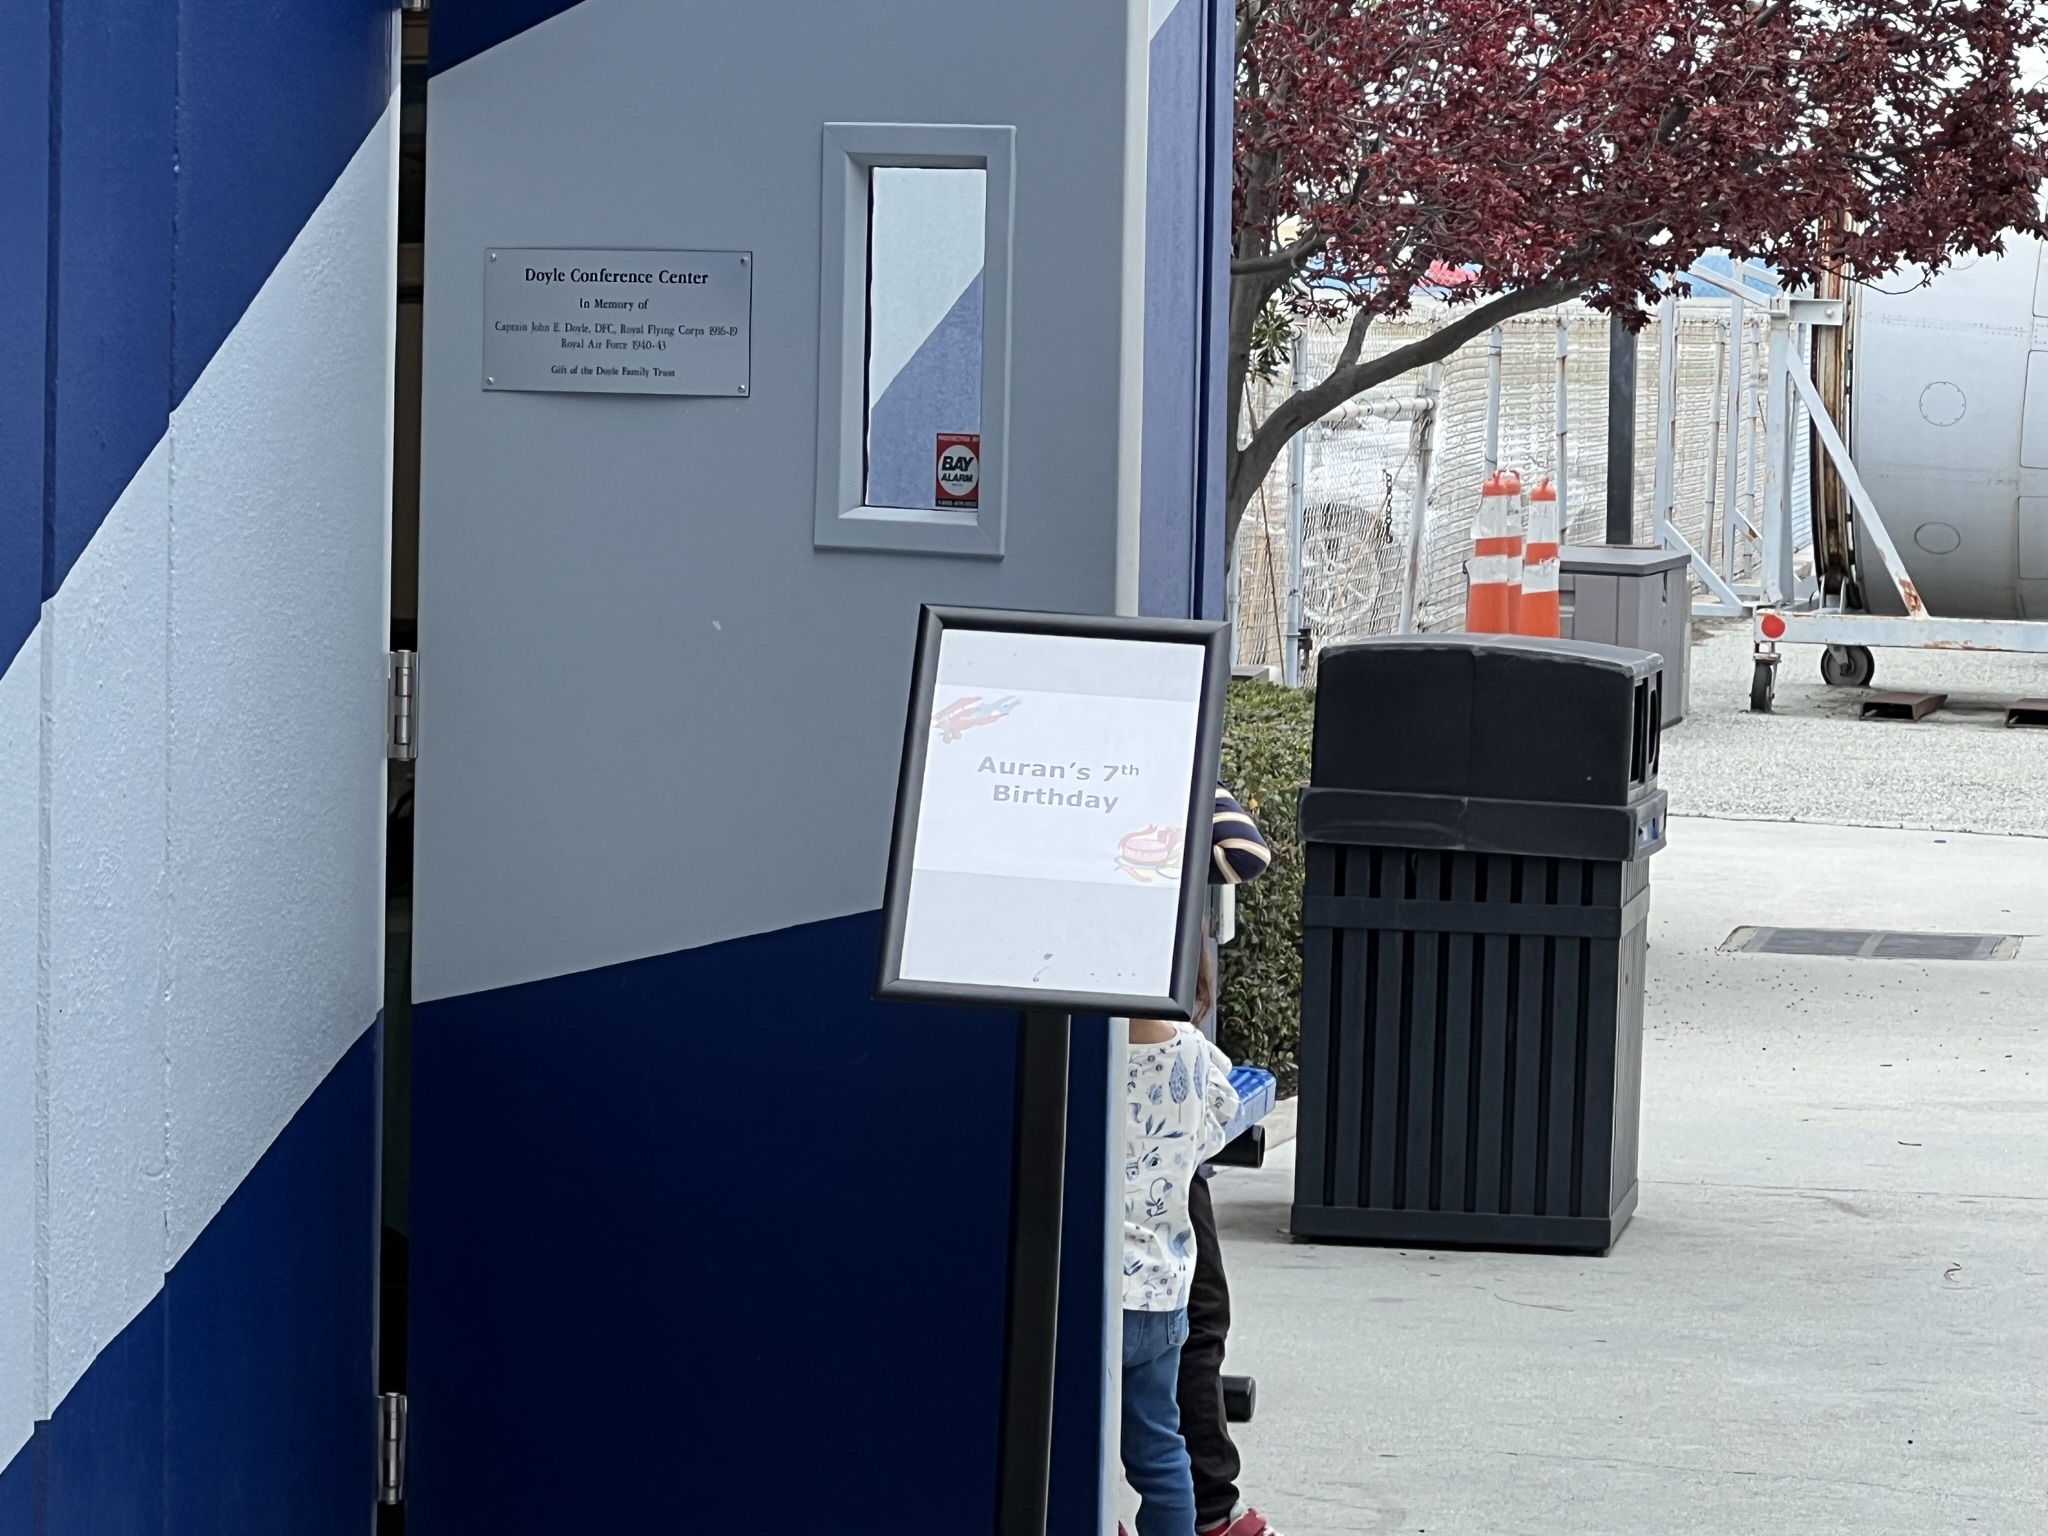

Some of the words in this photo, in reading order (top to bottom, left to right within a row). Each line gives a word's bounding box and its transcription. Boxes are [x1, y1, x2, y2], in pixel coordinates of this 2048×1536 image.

[525, 268, 565, 285] Doyle
[571, 269, 653, 284] Conference
[659, 270, 708, 284] Center
[580, 299, 590, 308] In
[594, 299, 634, 311] Memory
[638, 299, 649, 310] of
[495, 321, 527, 333] Captain
[530, 322, 549, 334] John
[595, 323, 616, 334] DFC,
[621, 324, 644, 336] Royal
[648, 325, 674, 336] Flying
[678, 325, 704, 337] Corps
[562, 339, 583, 350] Royal
[588, 339, 602, 349] Air
[606, 340, 627, 349] Force
[551, 365, 567, 374] Gift
[570, 366, 578, 374] of
[581, 367, 593, 375] the
[597, 367, 618, 376] Doyle
[622, 367, 649, 378] Family
[653, 368, 675, 376] Trust
[942, 456, 974, 471] BAY
[941, 473, 973, 482] ALARM
[978, 756, 1091, 781] Auran's
[1103, 763, 1139, 782] 7th
[993, 784, 1119, 814] Birthday
